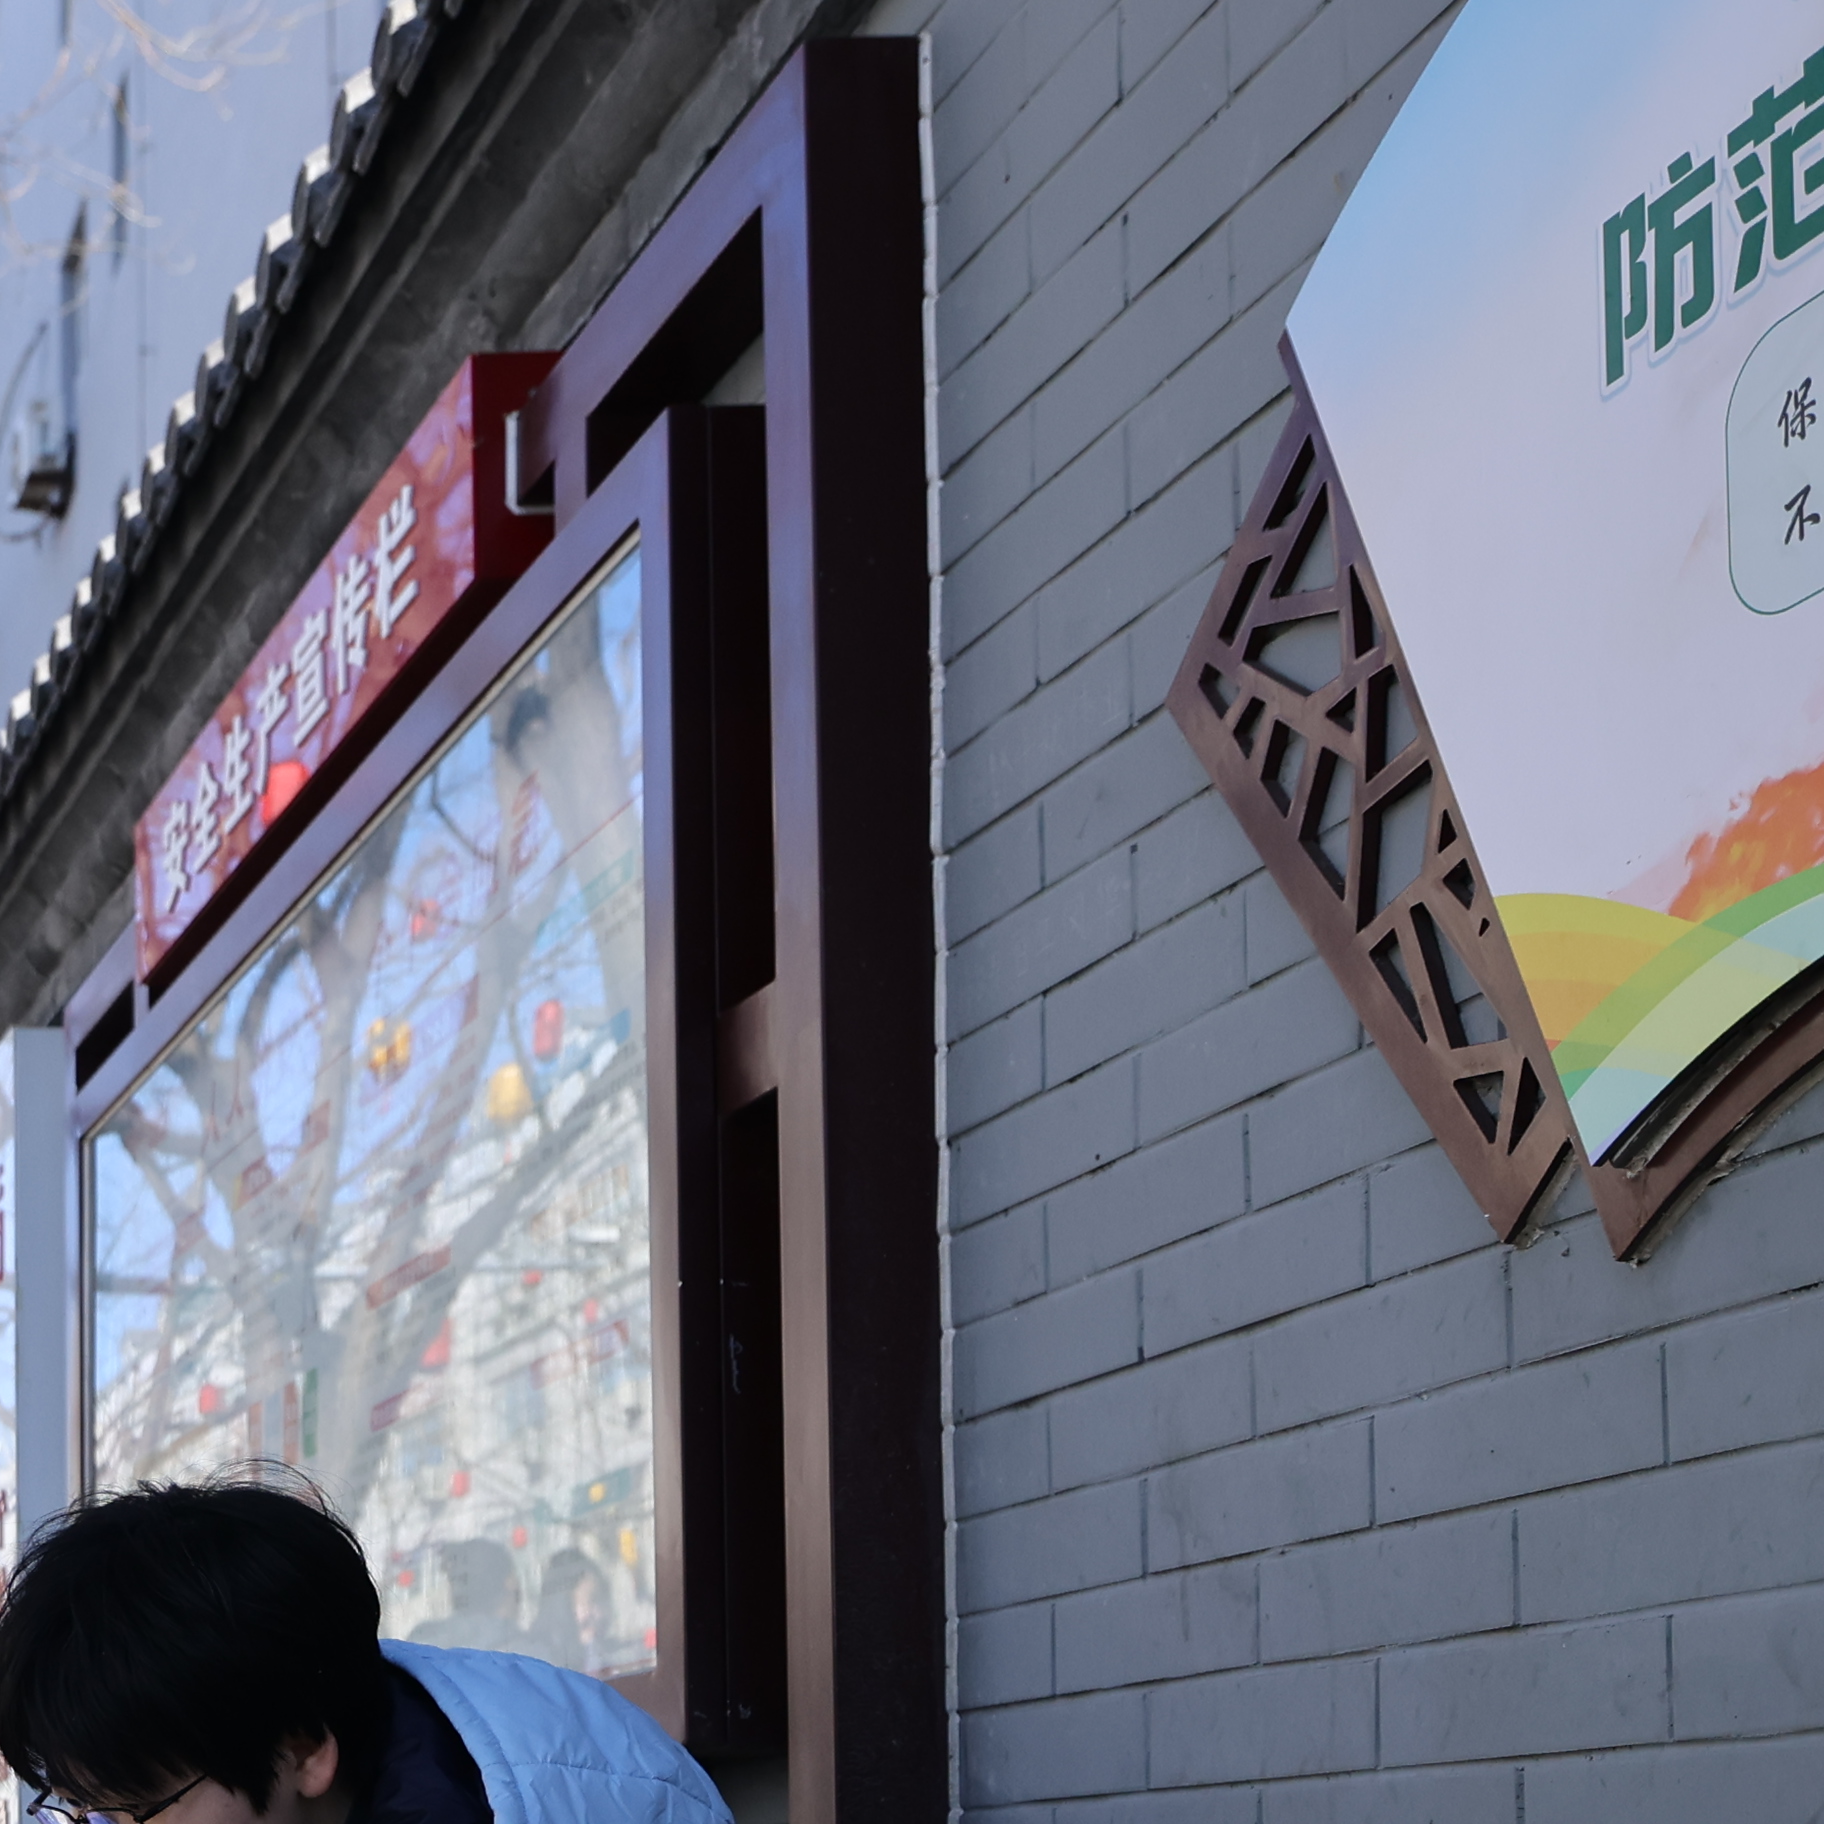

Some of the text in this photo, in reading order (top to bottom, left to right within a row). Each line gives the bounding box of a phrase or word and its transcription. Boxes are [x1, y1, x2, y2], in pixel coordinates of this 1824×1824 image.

[1777, 376, 1817, 448] 保
[1783, 484, 1821, 545] 不
[163, 484, 418, 913] 安全生产宣传栏
